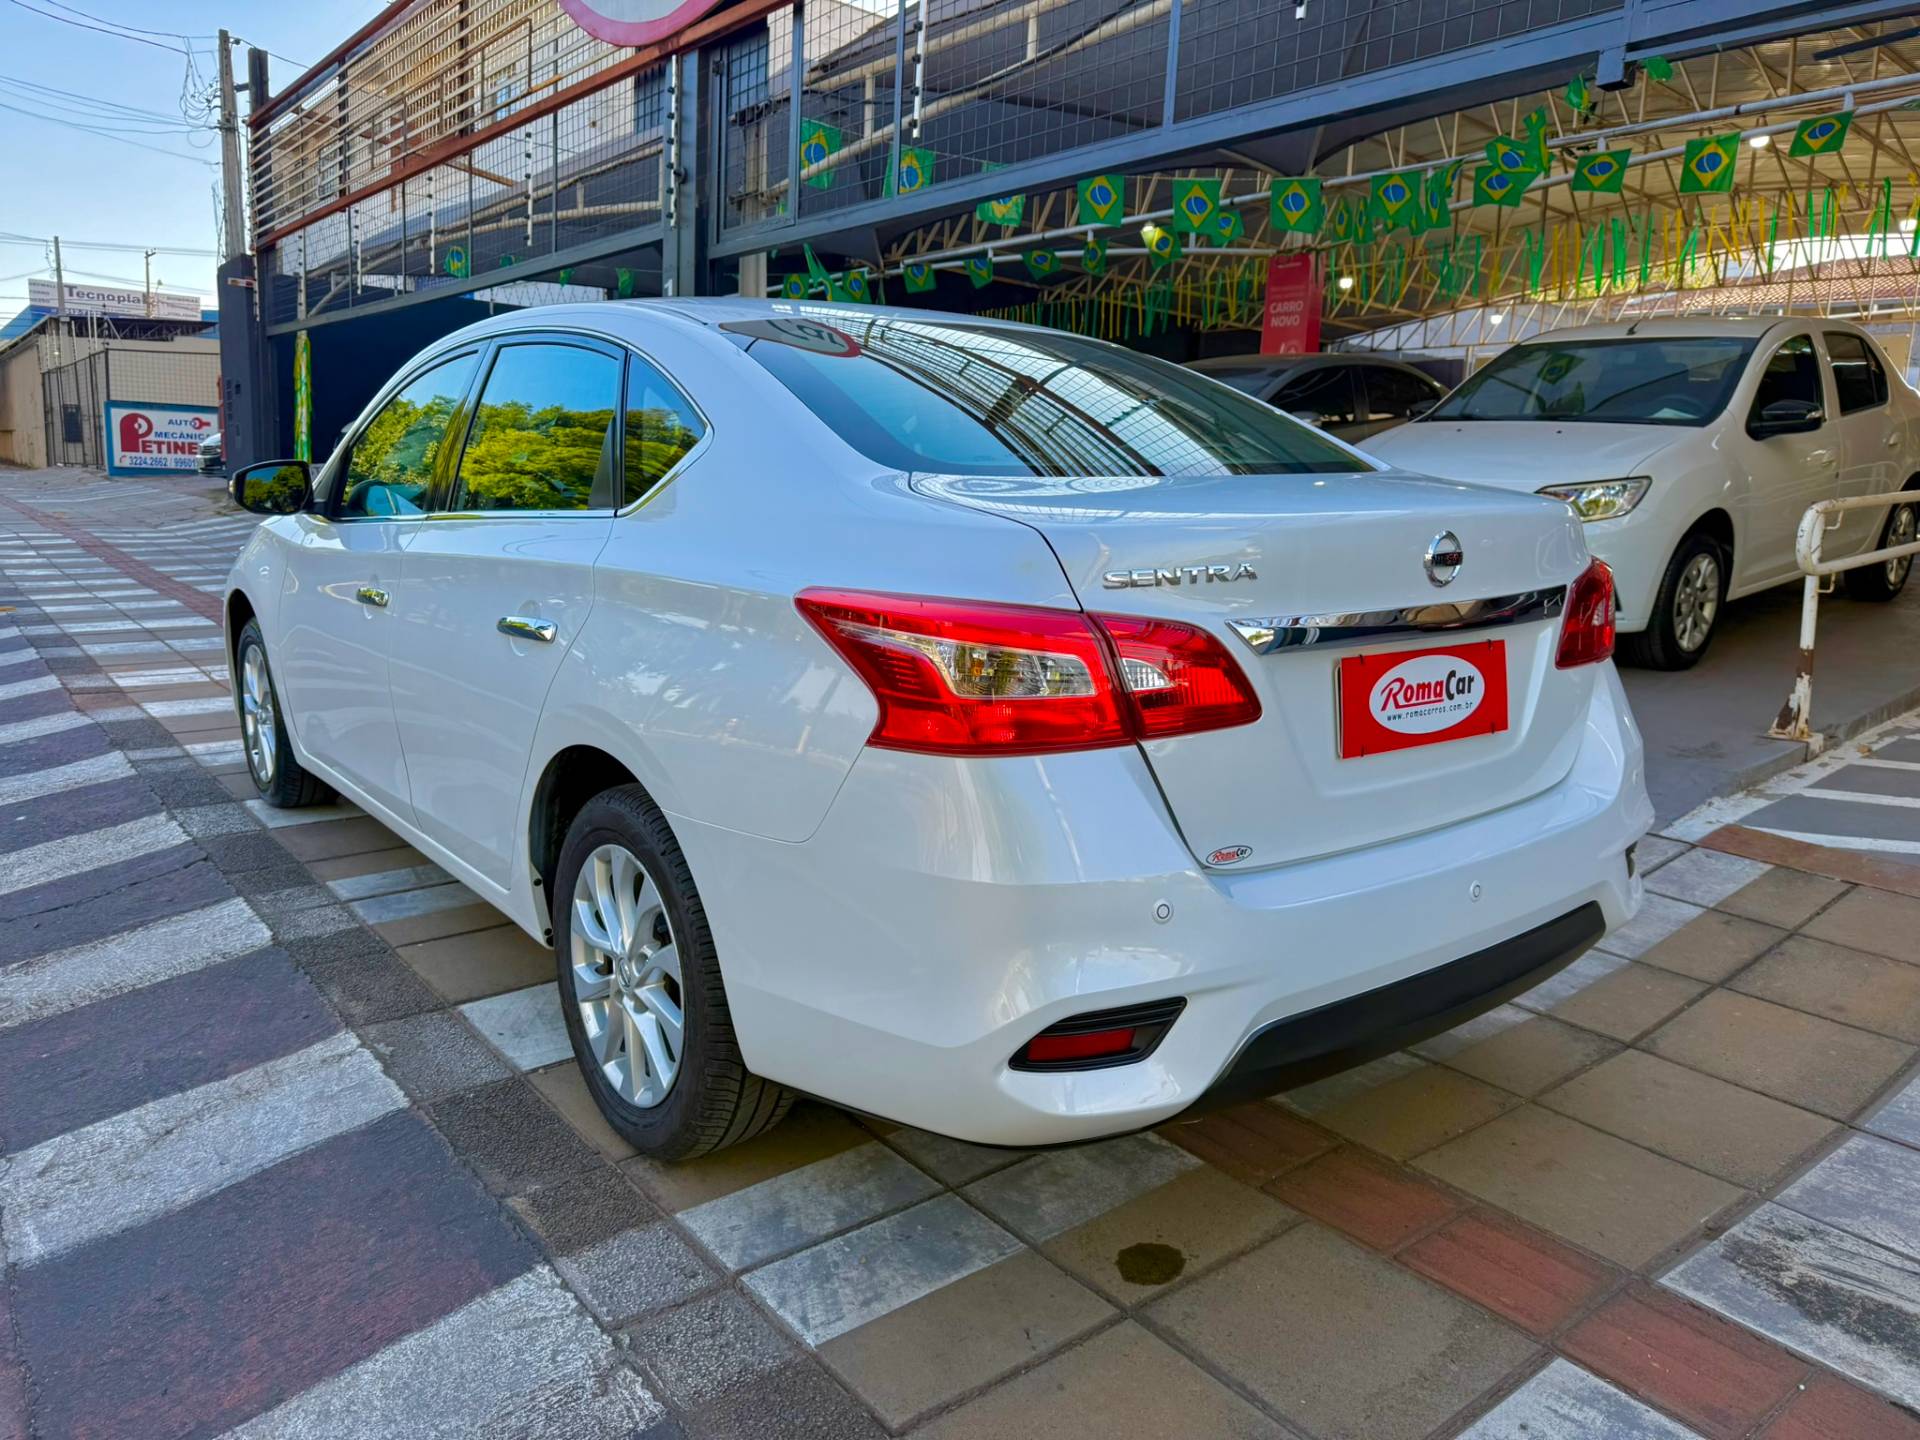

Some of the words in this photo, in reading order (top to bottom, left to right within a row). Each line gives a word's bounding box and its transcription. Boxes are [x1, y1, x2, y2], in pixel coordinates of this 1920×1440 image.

[1270, 301, 1304, 314] CARRO
[1270, 315, 1300, 328] NOVO
[168, 418, 197, 427] AUTO
[120, 413, 198, 455] PETINE
[1102, 563, 1258, 590] SENTRA
[1387, 700, 1474, 721] www.romacarros.com.br
